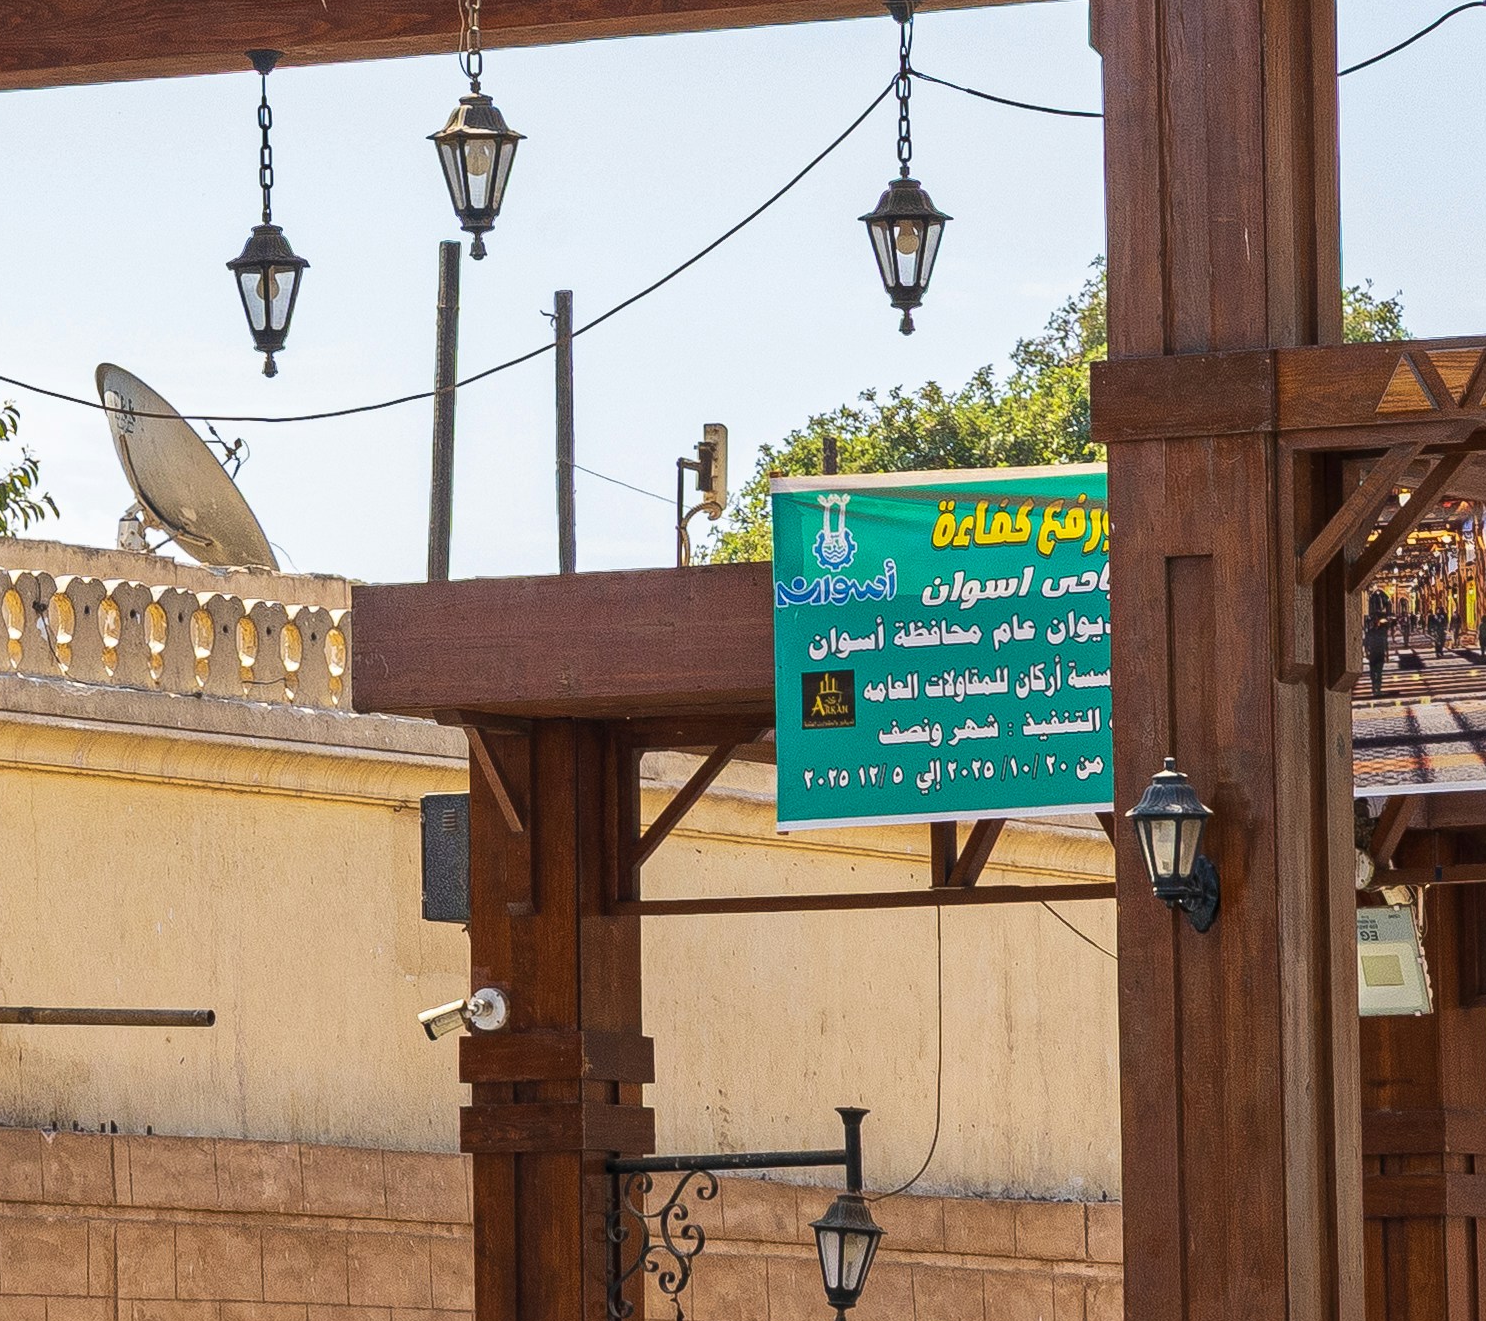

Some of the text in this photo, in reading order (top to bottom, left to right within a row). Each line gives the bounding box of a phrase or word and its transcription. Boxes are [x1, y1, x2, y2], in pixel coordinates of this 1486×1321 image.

[808, 609, 1111, 660] يوان عام محافظة أسوان
[924, 665, 1008, 703] للمقاولات
[1015, 655, 1062, 699] أركان
[1068, 660, 1111, 690] سسة
[878, 718, 943, 747] ونصف
[947, 714, 999, 746] شهر
[1023, 706, 1101, 740] التنفيذ
[1076, 755, 1104, 779] من
